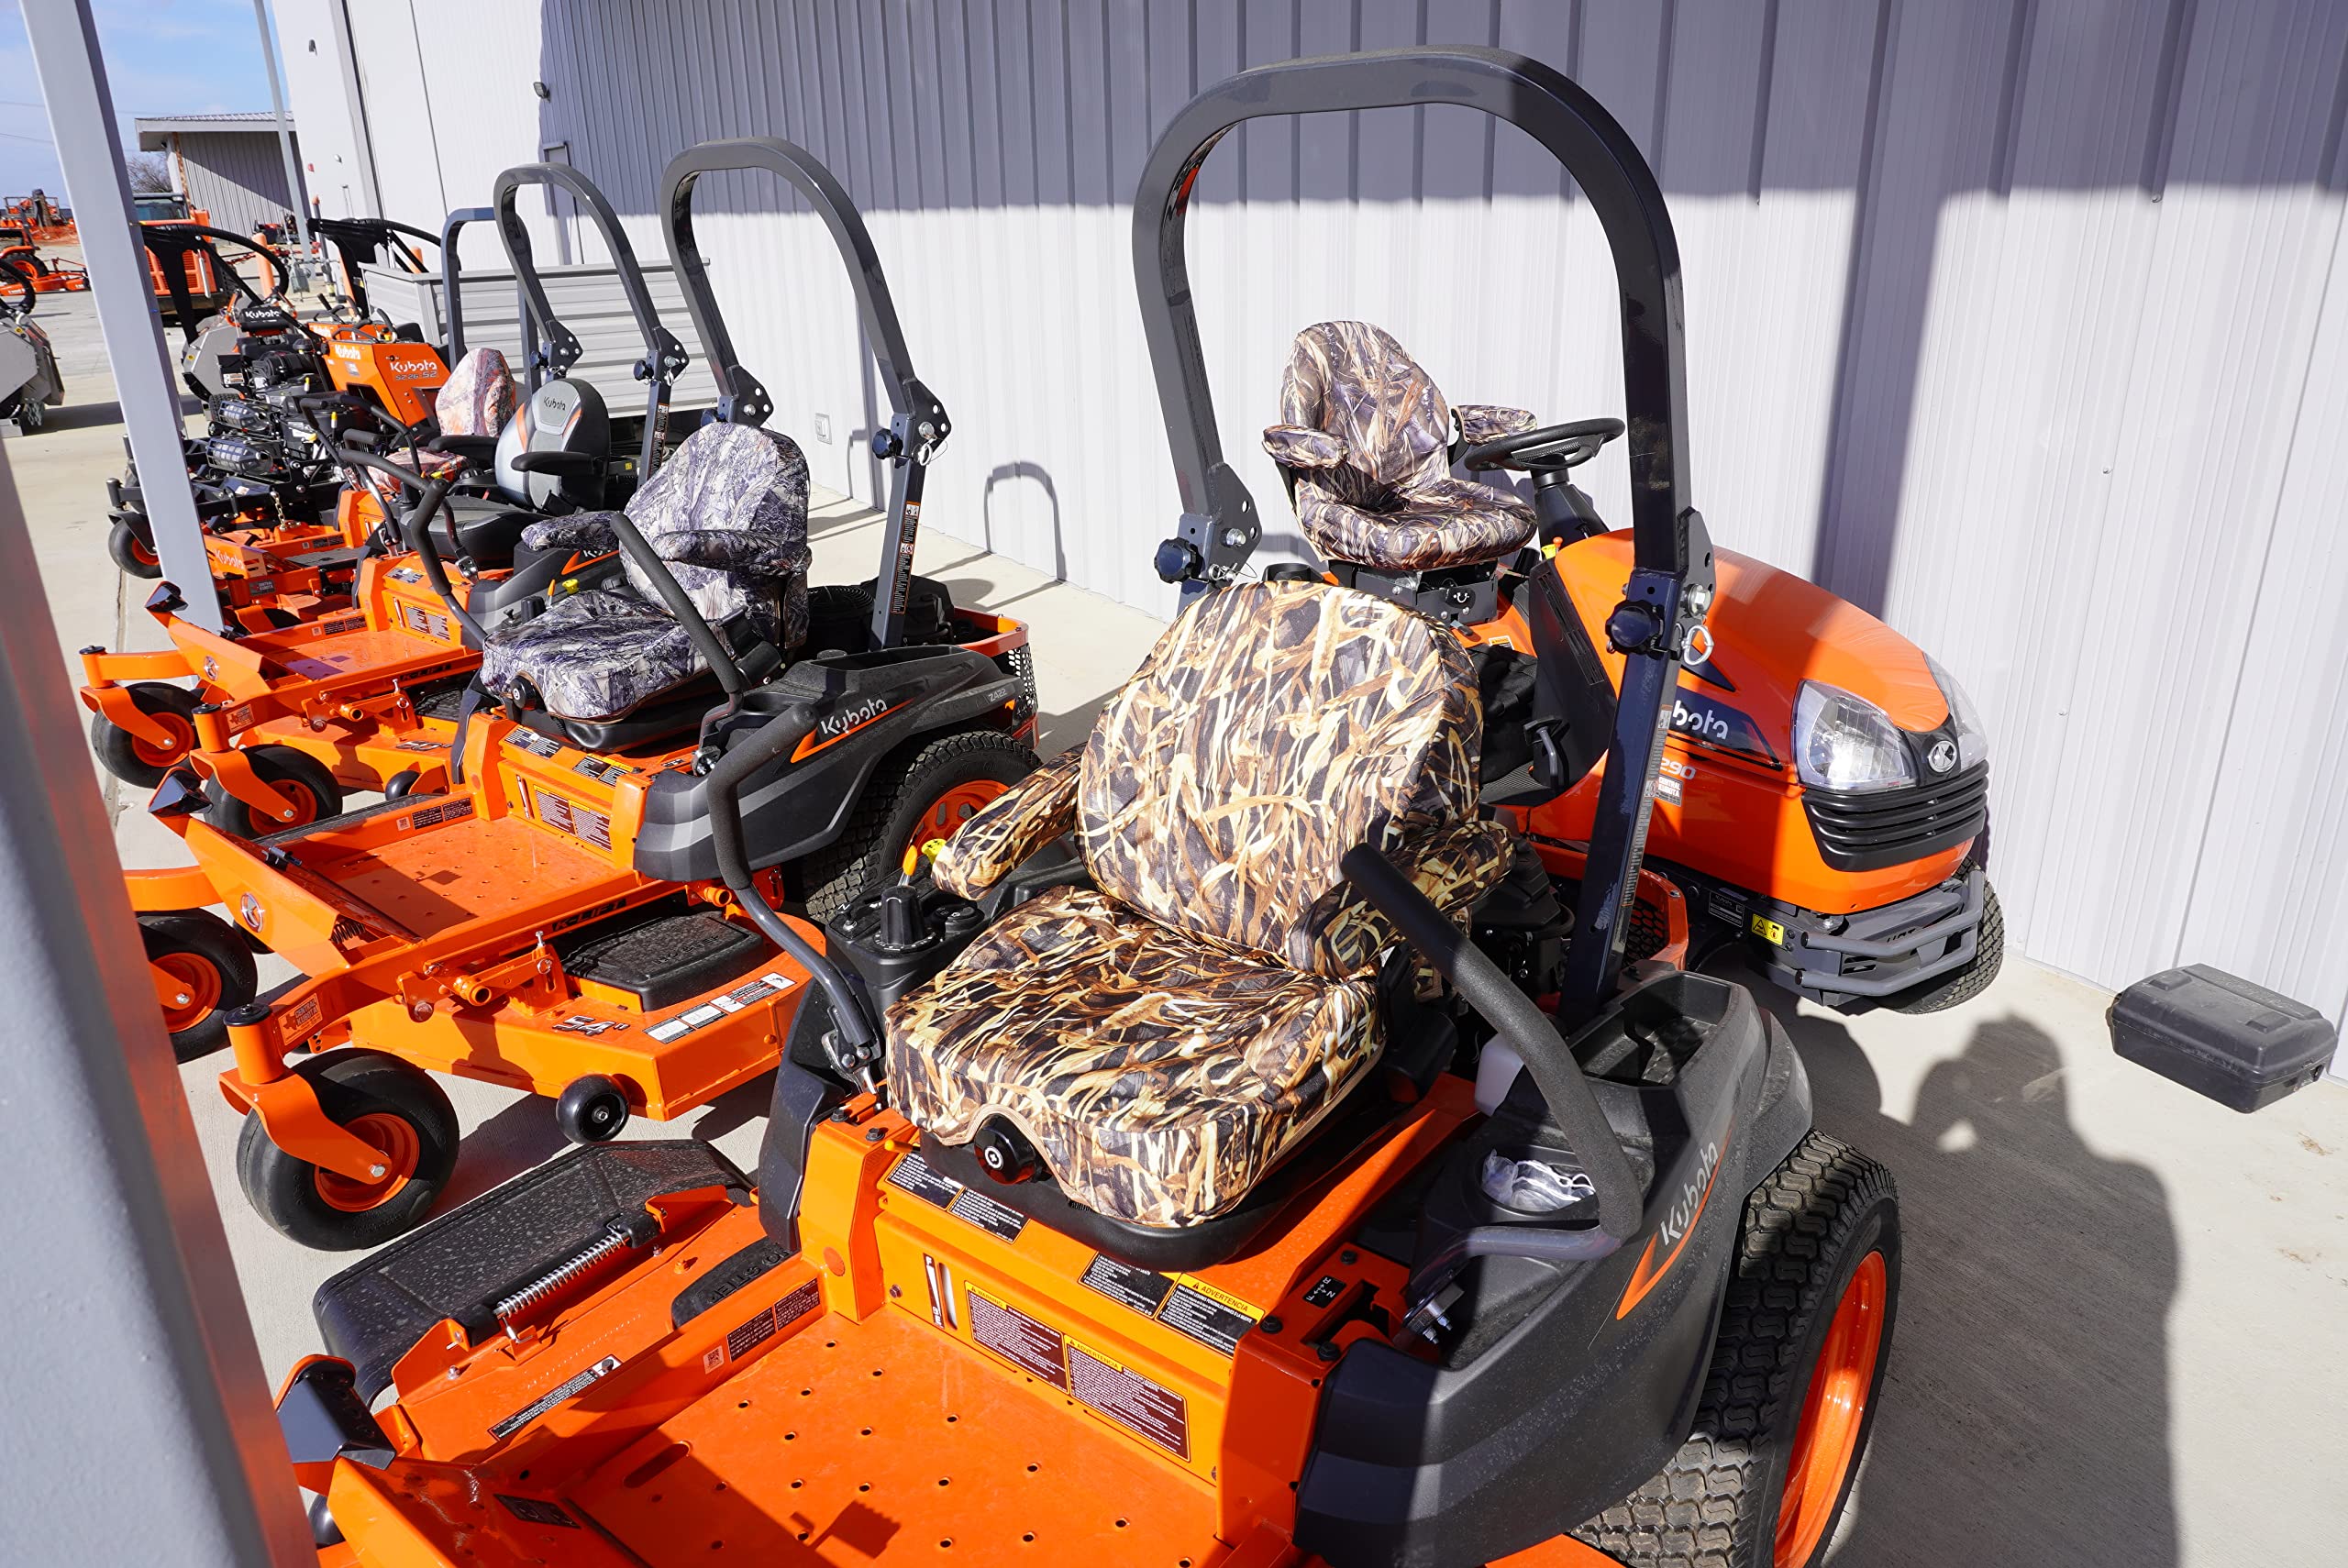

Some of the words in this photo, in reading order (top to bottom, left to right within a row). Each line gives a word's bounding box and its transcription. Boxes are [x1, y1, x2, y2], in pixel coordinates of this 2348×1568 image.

[245, 309, 281, 319] Kubota
[335, 344, 361, 359] Kubota
[390, 359, 438, 373] Kubota
[544, 396, 566, 411] Kubota
[214, 549, 245, 571] Kubota
[988, 688, 1008, 702] Z422
[820, 698, 888, 734] Kubota
[1672, 700, 1729, 740] bota
[1660, 1141, 1719, 1246] Kubota
[1322, 1276, 1332, 1285] R
[1200, 1286, 1249, 1312] ADVERTENCIA
[1325, 1290, 1336, 1298] N
[1077, 1343, 1119, 1370] ADVERTENCIA
